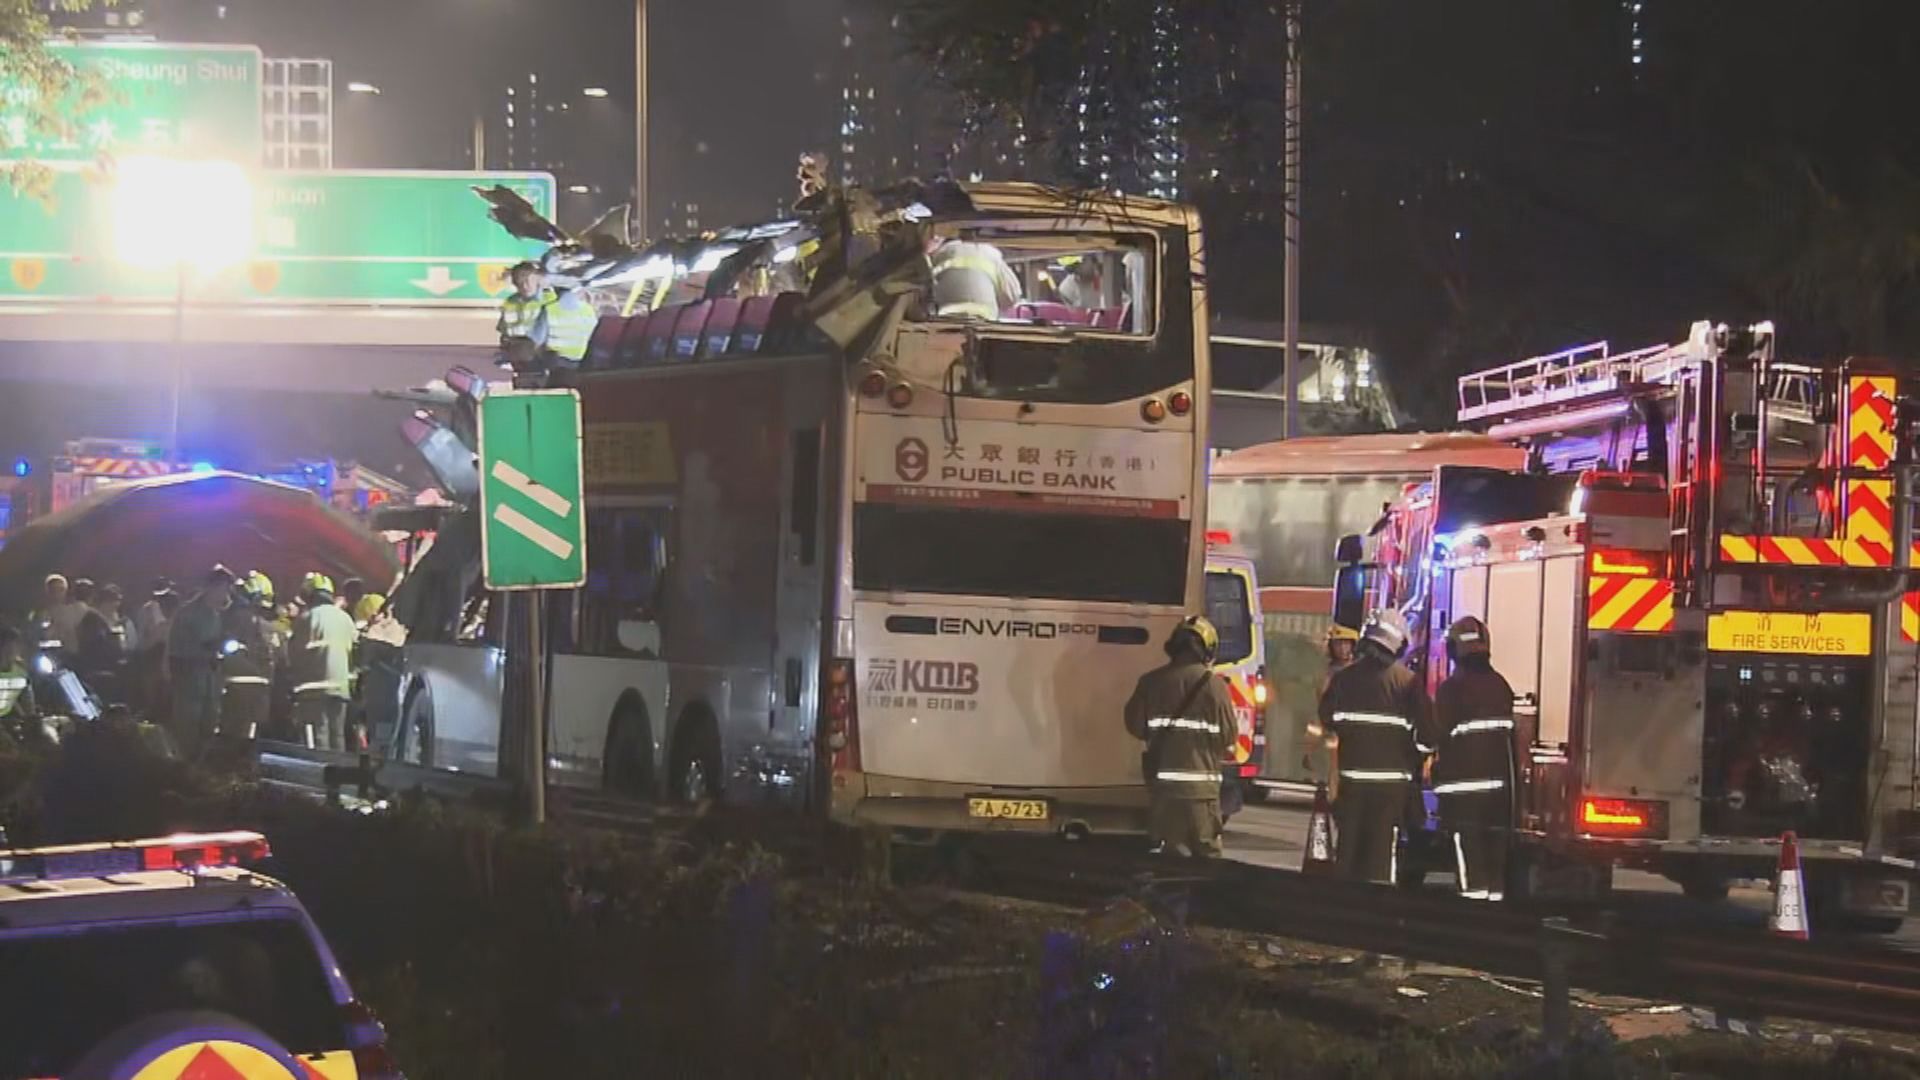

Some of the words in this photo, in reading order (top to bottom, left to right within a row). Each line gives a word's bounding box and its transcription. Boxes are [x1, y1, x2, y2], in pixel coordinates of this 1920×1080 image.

[99, 57, 188, 85] Sheung
[197, 58, 249, 81] Shui
[941, 466, 1035, 486] PUBLIC
[1043, 472, 1116, 491] BANK
[1733, 634, 1767, 649] FIRE
[1770, 636, 1845, 651] SERVICES
[902, 659, 979, 695] KMB
[1002, 801, 1044, 818] 6723
